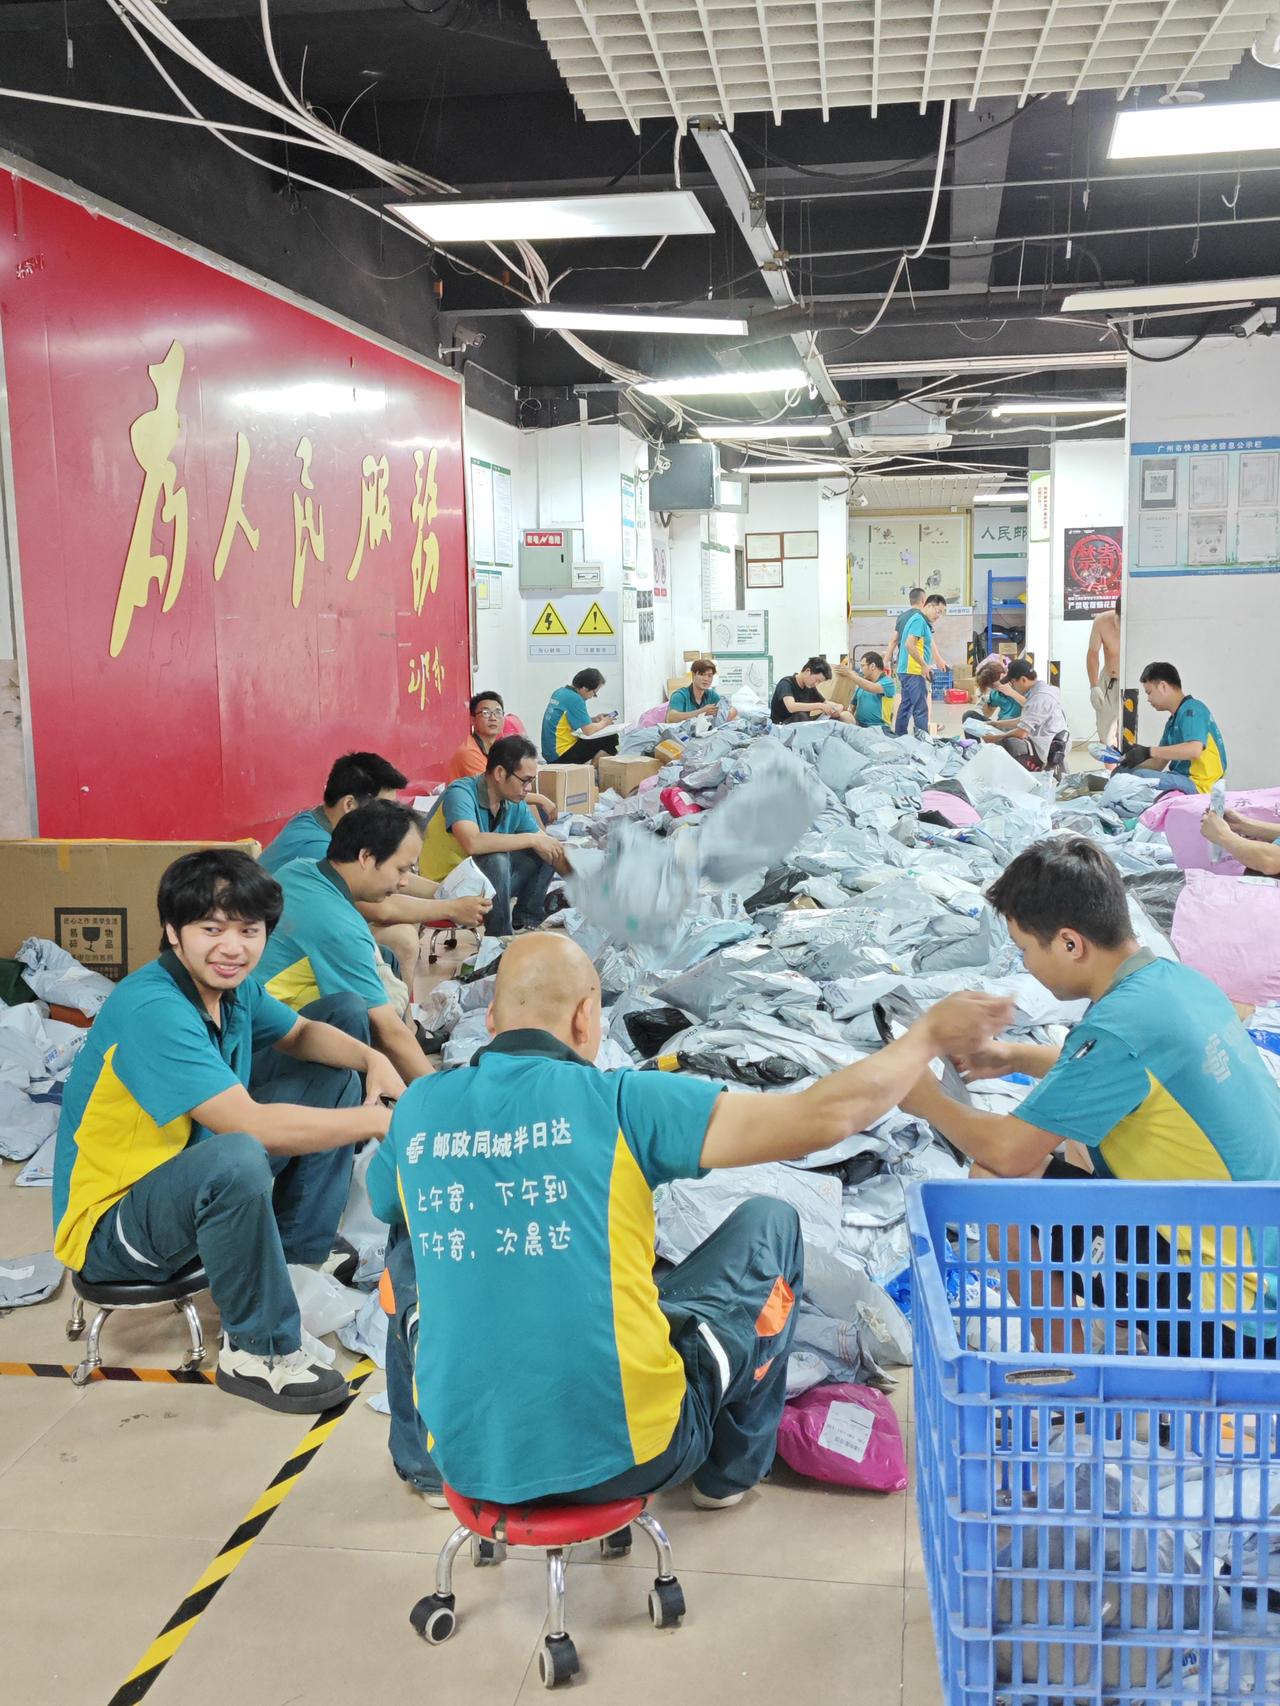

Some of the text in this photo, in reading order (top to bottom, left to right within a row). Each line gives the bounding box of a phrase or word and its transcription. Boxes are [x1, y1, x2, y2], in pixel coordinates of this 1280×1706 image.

[433, 1117, 572, 1160] 邮政同城半日达
[495, 1175, 568, 1207] 下午到
[496, 1220, 571, 1256] 次晨达
